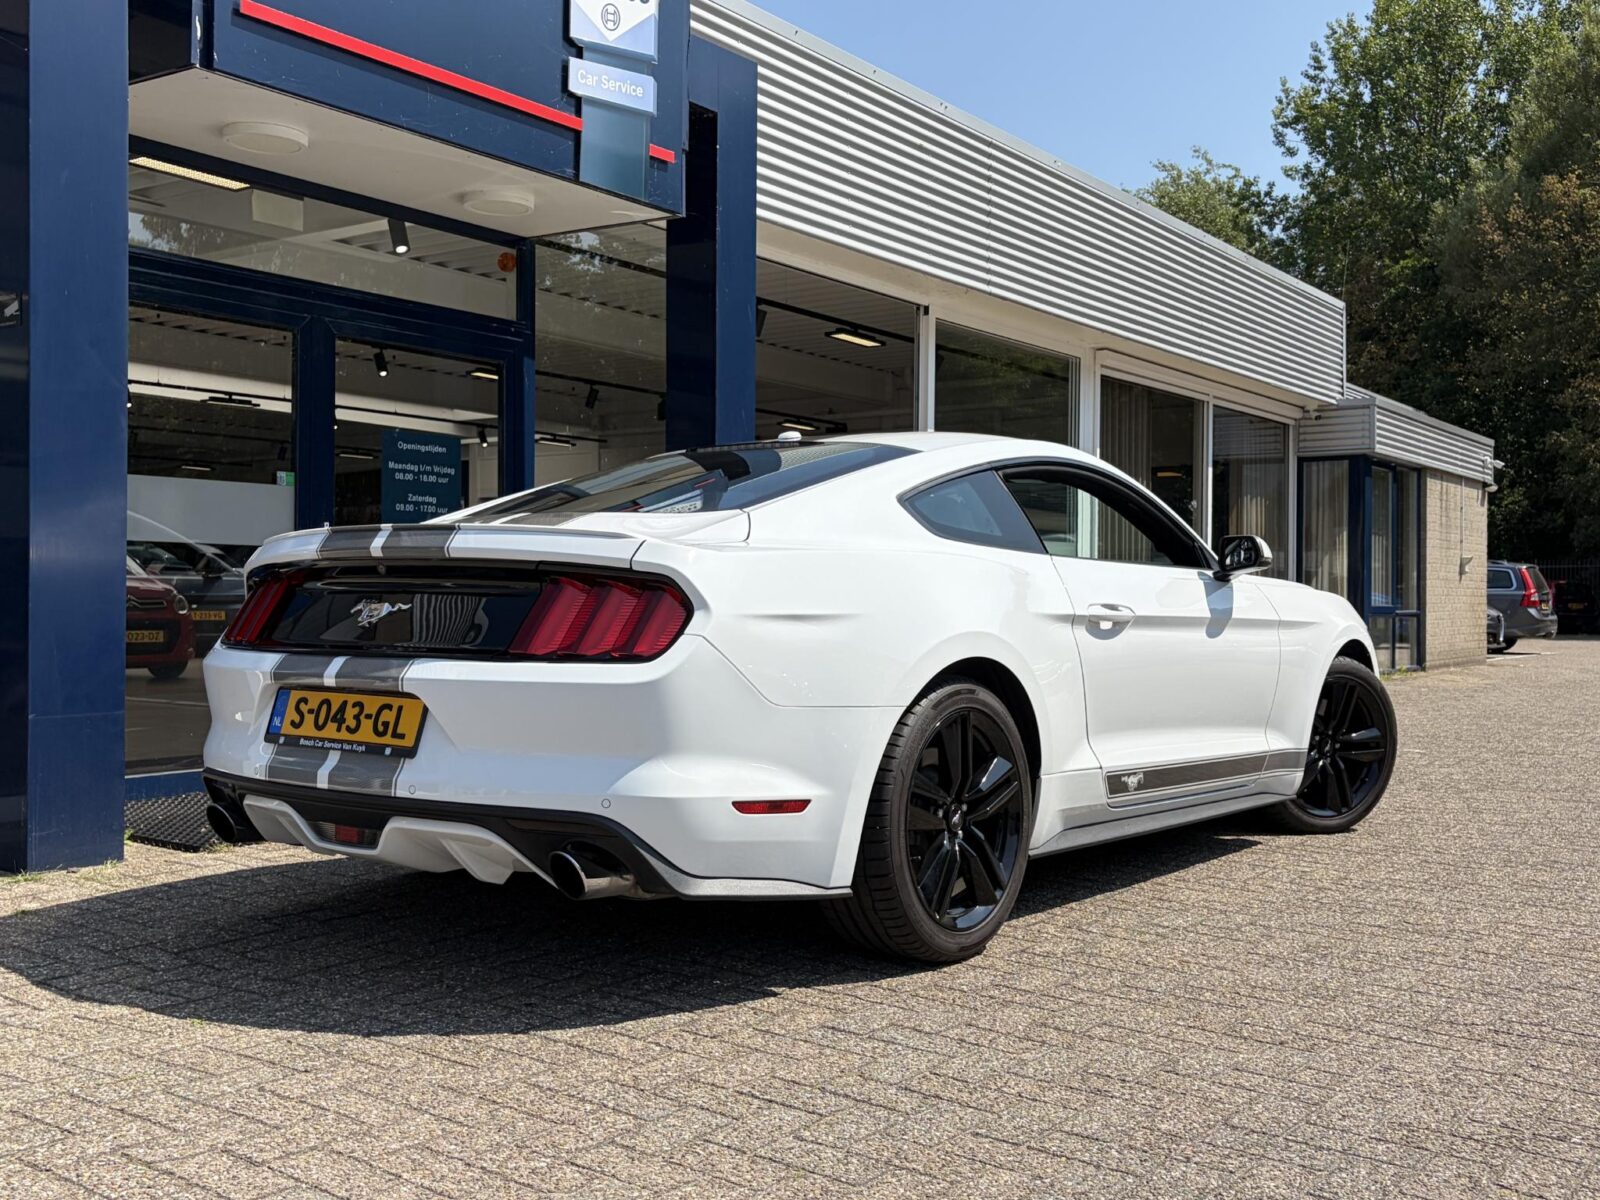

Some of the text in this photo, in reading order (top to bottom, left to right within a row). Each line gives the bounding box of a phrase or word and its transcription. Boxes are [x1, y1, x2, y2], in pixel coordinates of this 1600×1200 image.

[577, 70, 643, 97] Car Service
[397, 441, 447, 453] Openingstijden
[388, 461, 455, 475] Maandag t/m Vrijdag
[395, 472, 413, 480] 08.00
[420, 474, 437, 483] 18.00
[408, 494, 437, 504] Zaterdag
[395, 503, 414, 511] 09.00
[272, 716, 282, 727] NL
[289, 696, 406, 740] S-043-GL
[299, 738, 314, 746] Bosch
[324, 740, 342, 749] Service
[343, 742, 352, 750] Van
